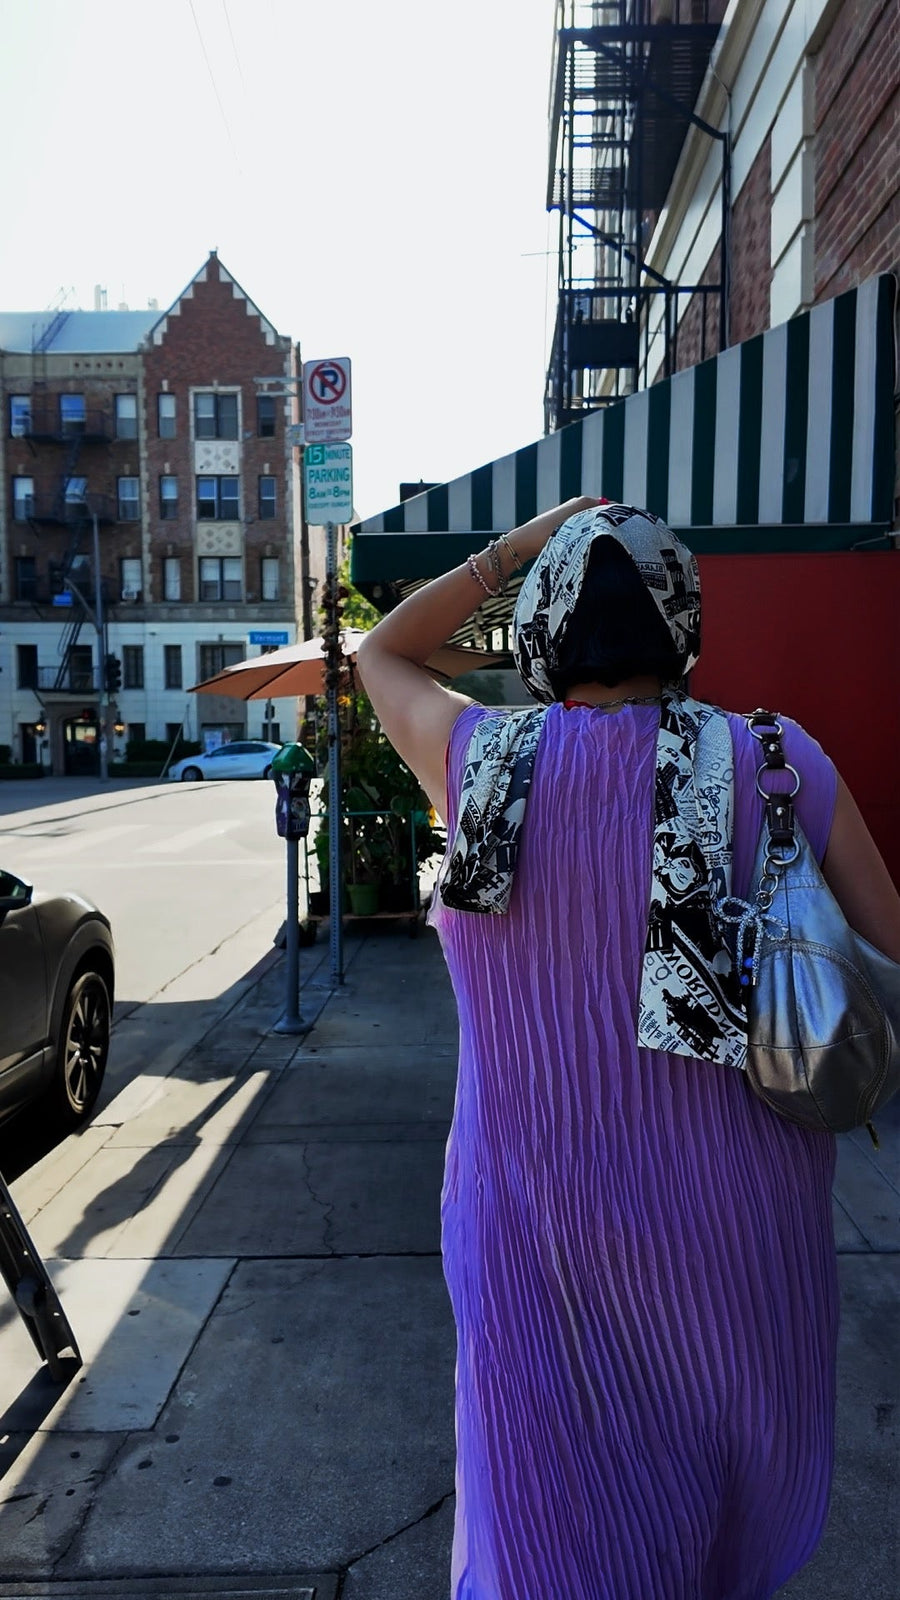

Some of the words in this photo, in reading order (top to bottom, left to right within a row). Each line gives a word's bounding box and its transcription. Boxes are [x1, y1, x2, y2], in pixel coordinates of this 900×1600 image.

[308, 446, 323, 464] 15
[325, 448, 350, 460] MINUTE
[308, 467, 350, 484] PARKING
